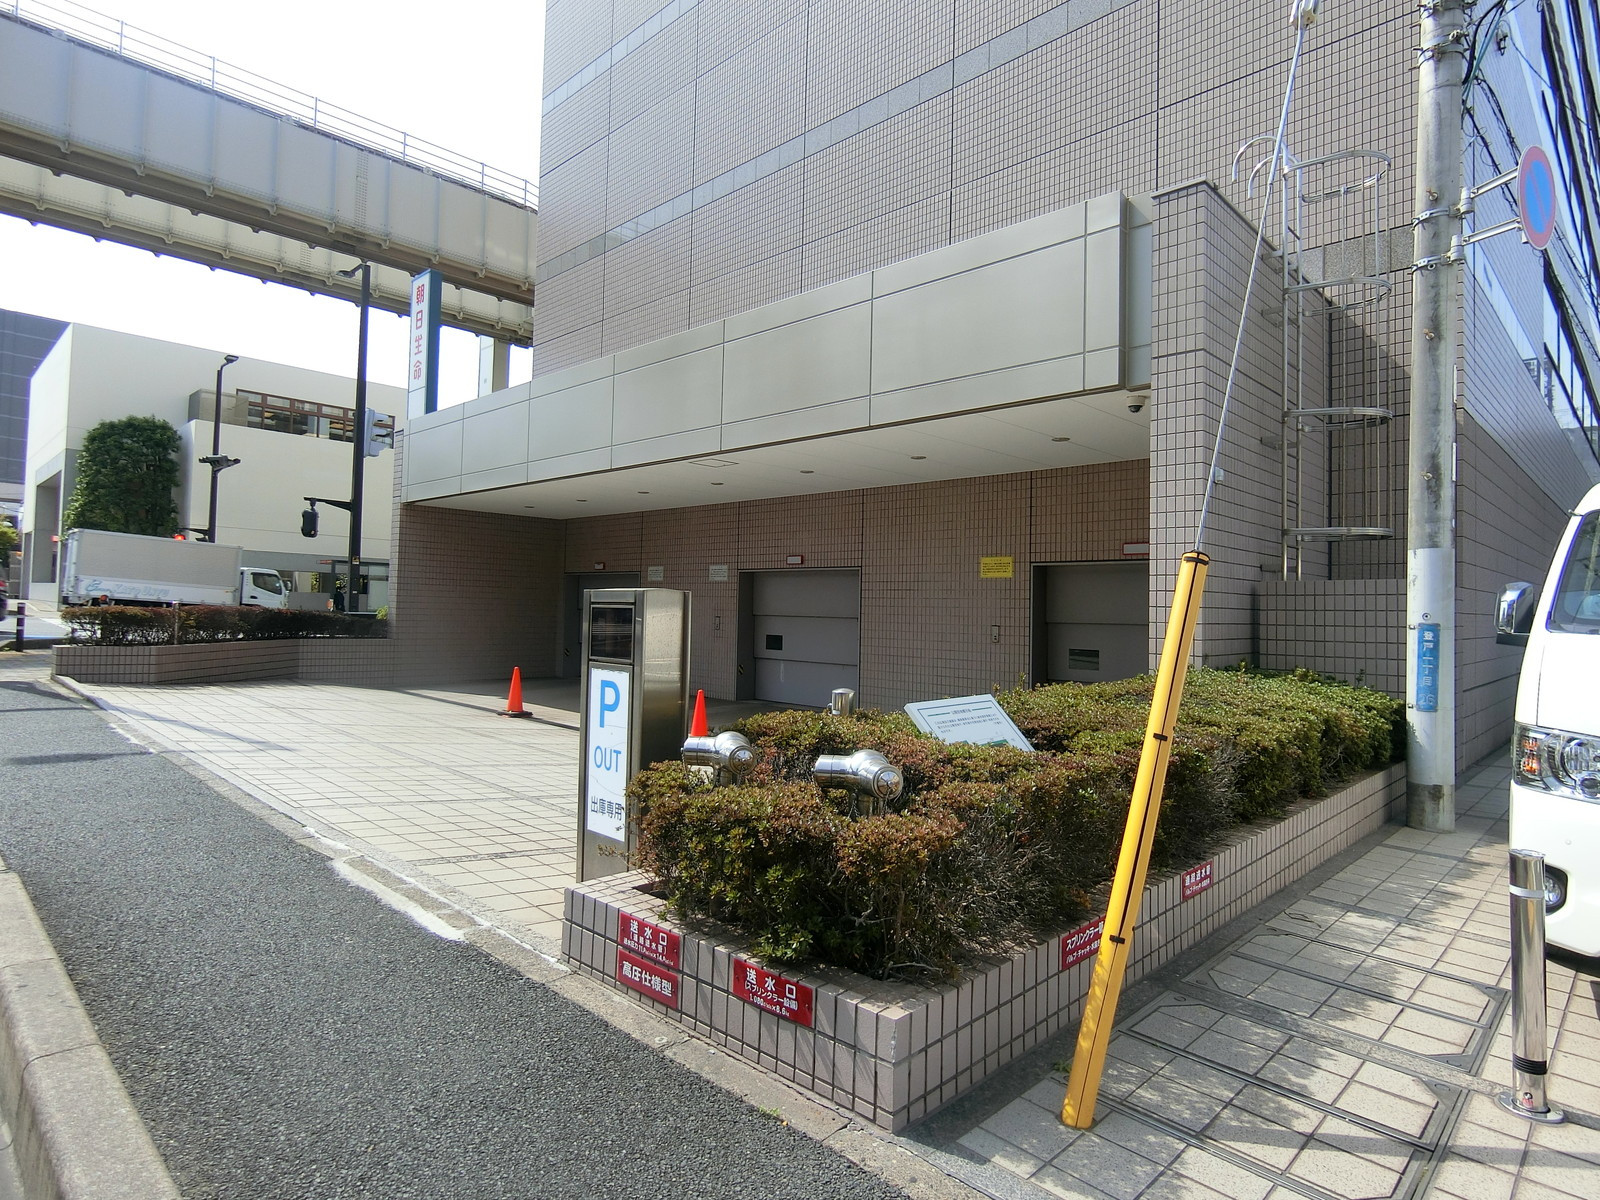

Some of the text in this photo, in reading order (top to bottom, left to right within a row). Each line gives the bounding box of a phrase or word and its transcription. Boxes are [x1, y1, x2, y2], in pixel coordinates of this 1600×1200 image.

[413, 283, 426, 381] 朝日生命
[1423, 631, 1435, 687] 登戸一丁目
[599, 679, 621, 729] P
[593, 745, 622, 773] OUT
[590, 795, 623, 822] 出庫専用
[630, 919, 668, 946] 送水口
[622, 961, 672, 997] 高圧仕様型
[746, 968, 797, 999] 送水口
